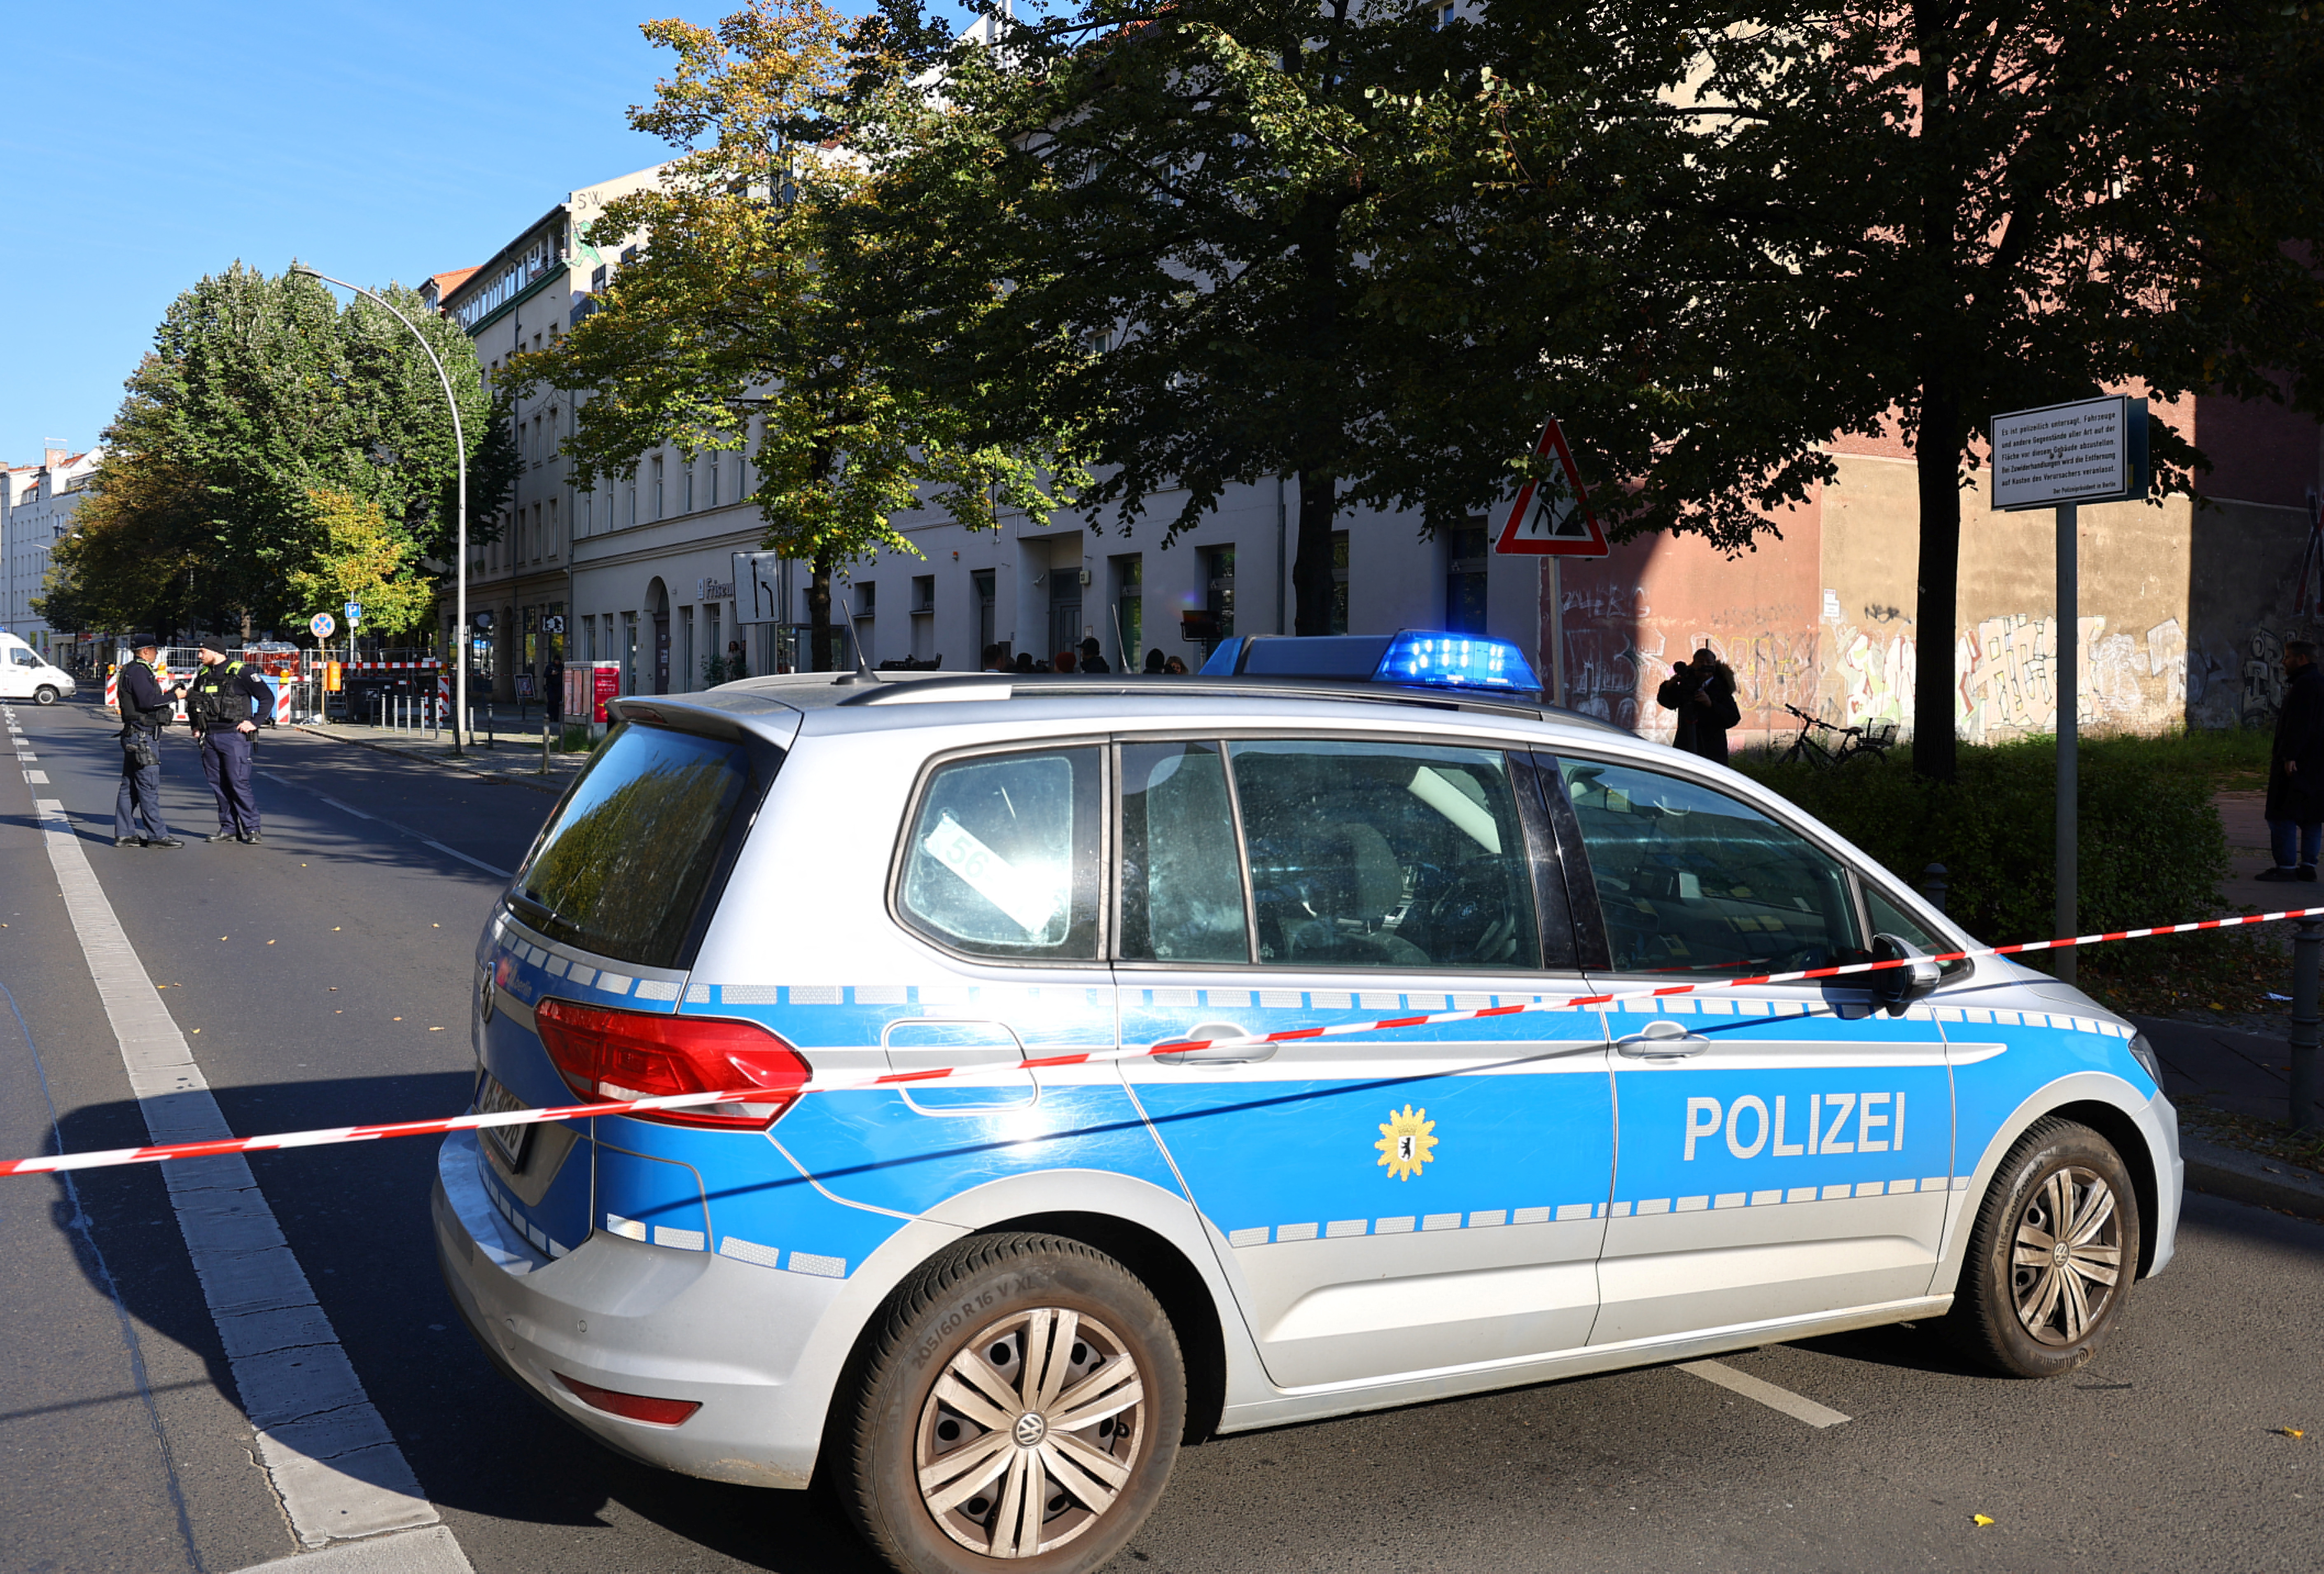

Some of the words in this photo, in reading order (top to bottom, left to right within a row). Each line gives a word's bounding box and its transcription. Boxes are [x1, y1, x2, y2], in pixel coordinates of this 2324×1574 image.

[2020, 422, 2048, 435] polizeilich
[2084, 412, 2116, 423] Fahrzeuge
[2032, 432, 2066, 444] Gegenstände
[2002, 452, 2019, 461] Fläche
[2053, 443, 2077, 453] Gebäude
[2080, 439, 2116, 449] abzustellen.
[2011, 460, 2060, 473] Zuwiderhandlungen
[2085, 453, 2116, 462] Entfernung
[2002, 479, 2011, 487] auf
[2044, 470, 2081, 481] Verursachers
[1684, 1092, 1905, 1161] POLIZEI
[912, 1313, 962, 1370] 205/60
[962, 1303, 976, 1317] R
[975, 1290, 993, 1309] 16
[997, 1282, 1008, 1297] V
[1014, 1275, 1036, 1292] XL
